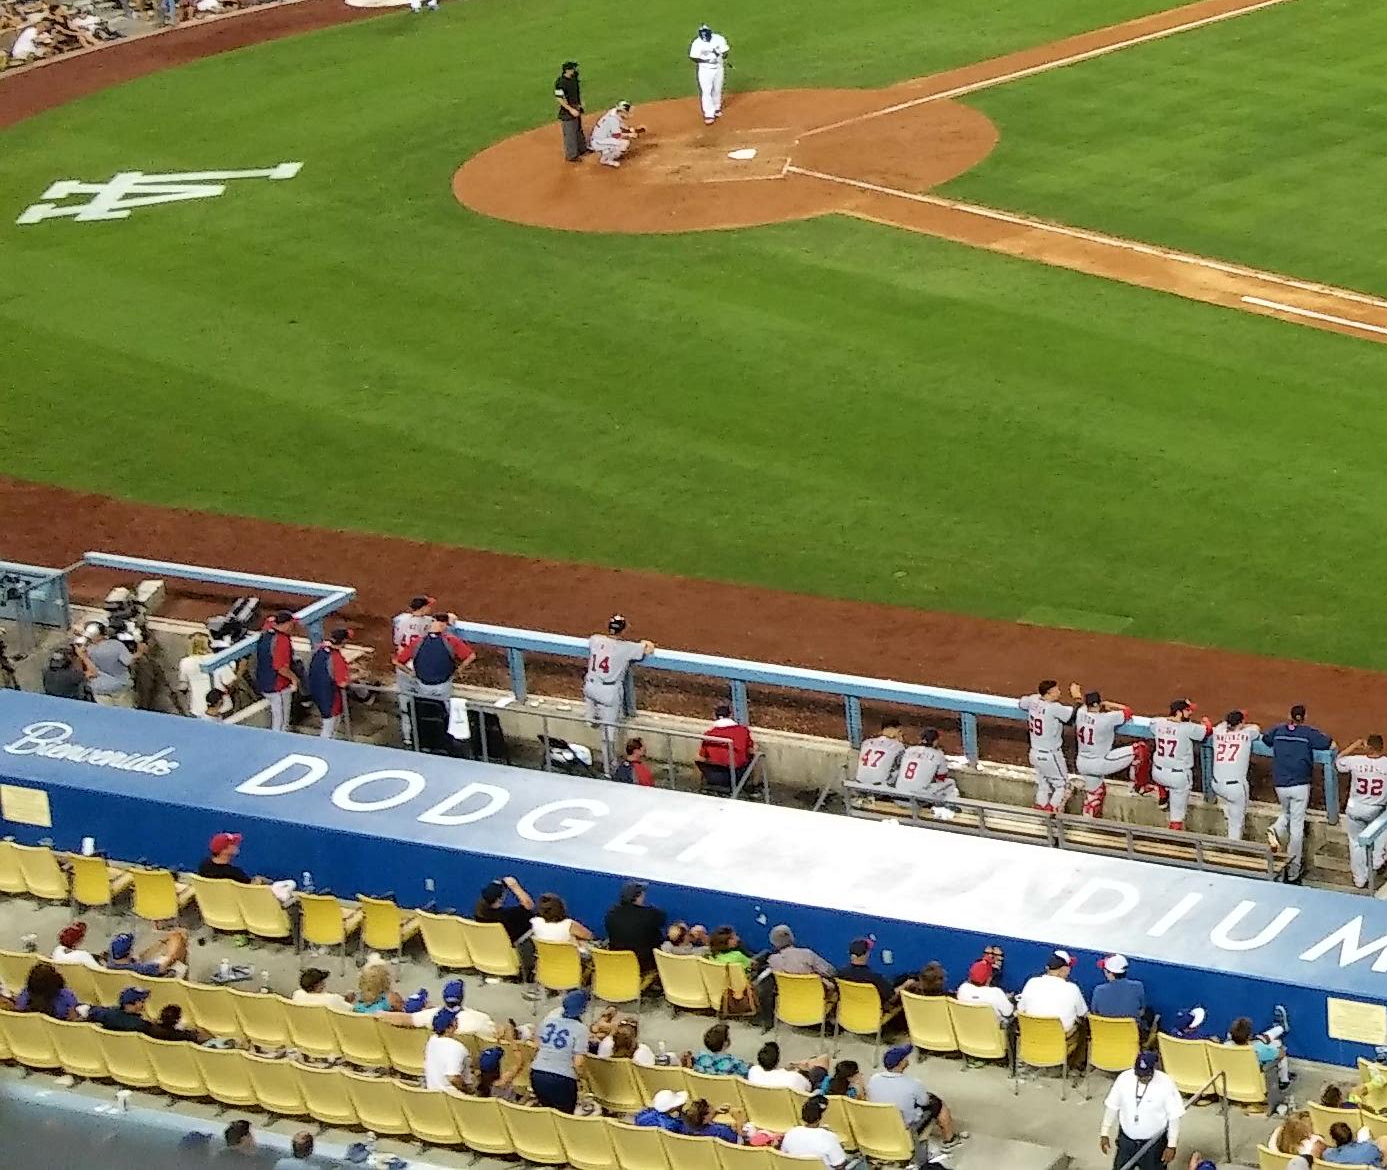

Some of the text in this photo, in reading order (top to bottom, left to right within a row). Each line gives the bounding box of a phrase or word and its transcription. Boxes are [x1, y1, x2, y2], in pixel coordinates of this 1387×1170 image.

[591, 654, 610, 674] 14
[1076, 727, 1094, 746] 41
[2, 720, 181, 777] Bienvenidos
[1157, 738, 1178, 758] 57
[1216, 743, 1240, 762] 27
[862, 749, 886, 768] 47
[905, 761, 918, 780] 8
[1356, 777, 1384, 796] 32
[538, 1022, 570, 1050] 36
